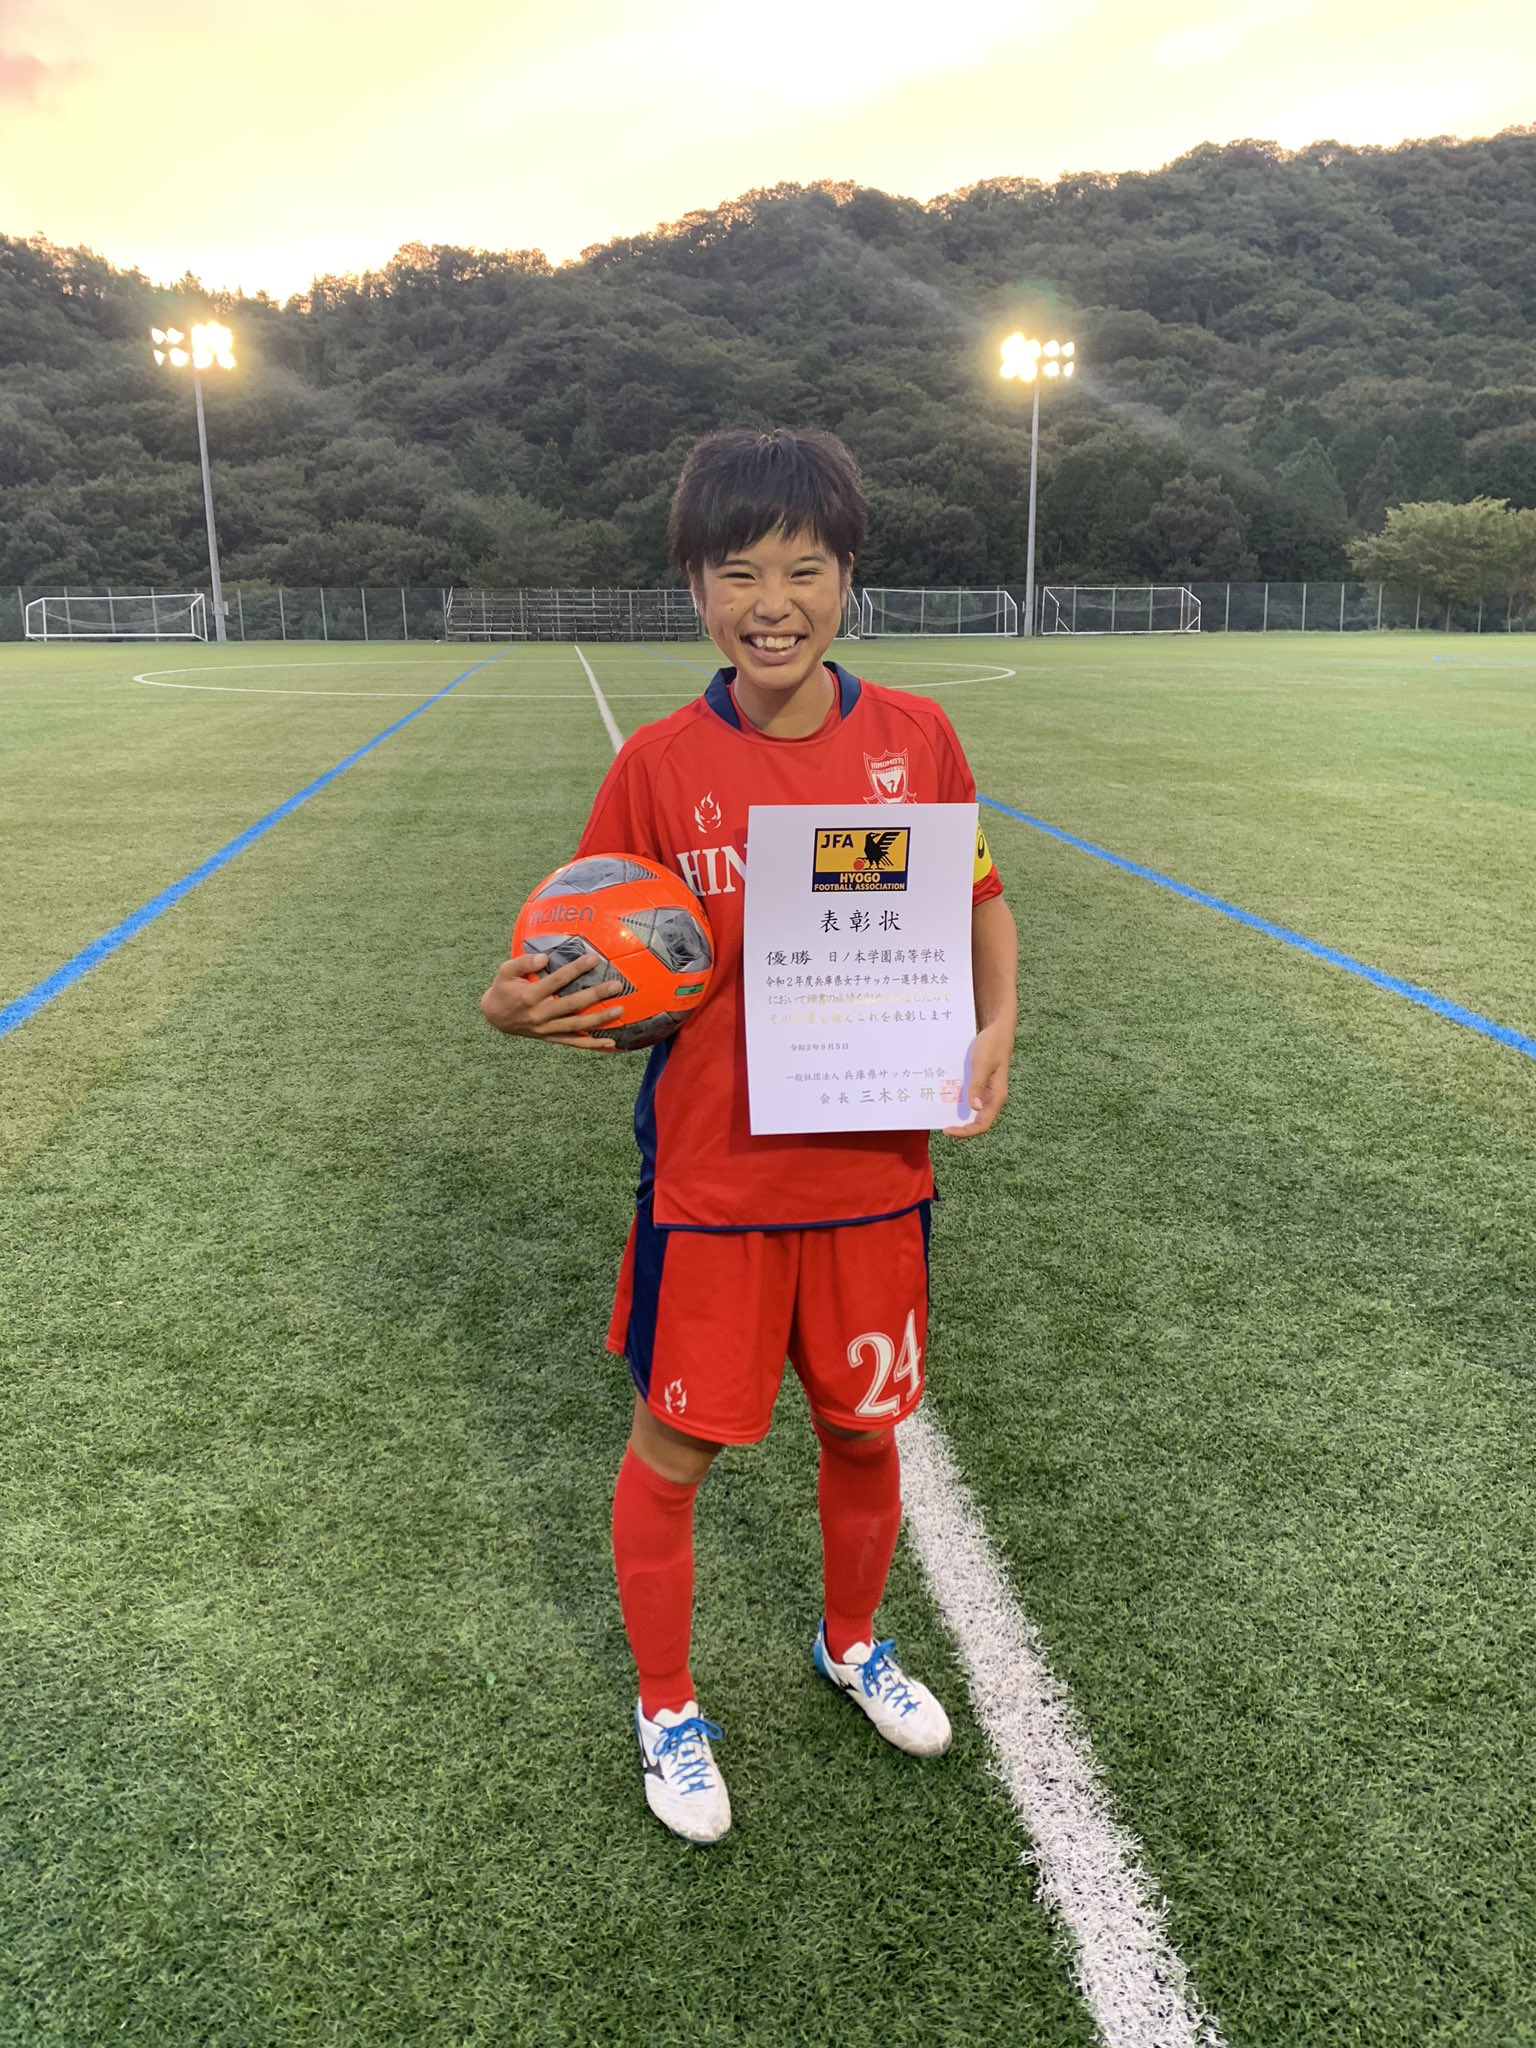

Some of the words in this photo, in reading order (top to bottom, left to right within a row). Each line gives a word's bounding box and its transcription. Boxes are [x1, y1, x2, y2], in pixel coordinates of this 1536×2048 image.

[820, 834, 854, 849] JFA
[839, 872, 881, 883] HYOGO
[814, 883, 853, 891] FOOTBALL
[855, 882, 905, 891] ASSOCIATION
[528, 905, 594, 924] molten
[819, 909, 902, 933] 表彰状
[765, 950, 813, 966] 優勝
[828, 949, 946, 965] 日ノ本学園高等学校
[819, 1092, 850, 1105] 会長
[859, 1087, 912, 1104] 三木谷
[846, 1308, 922, 1418] 24
